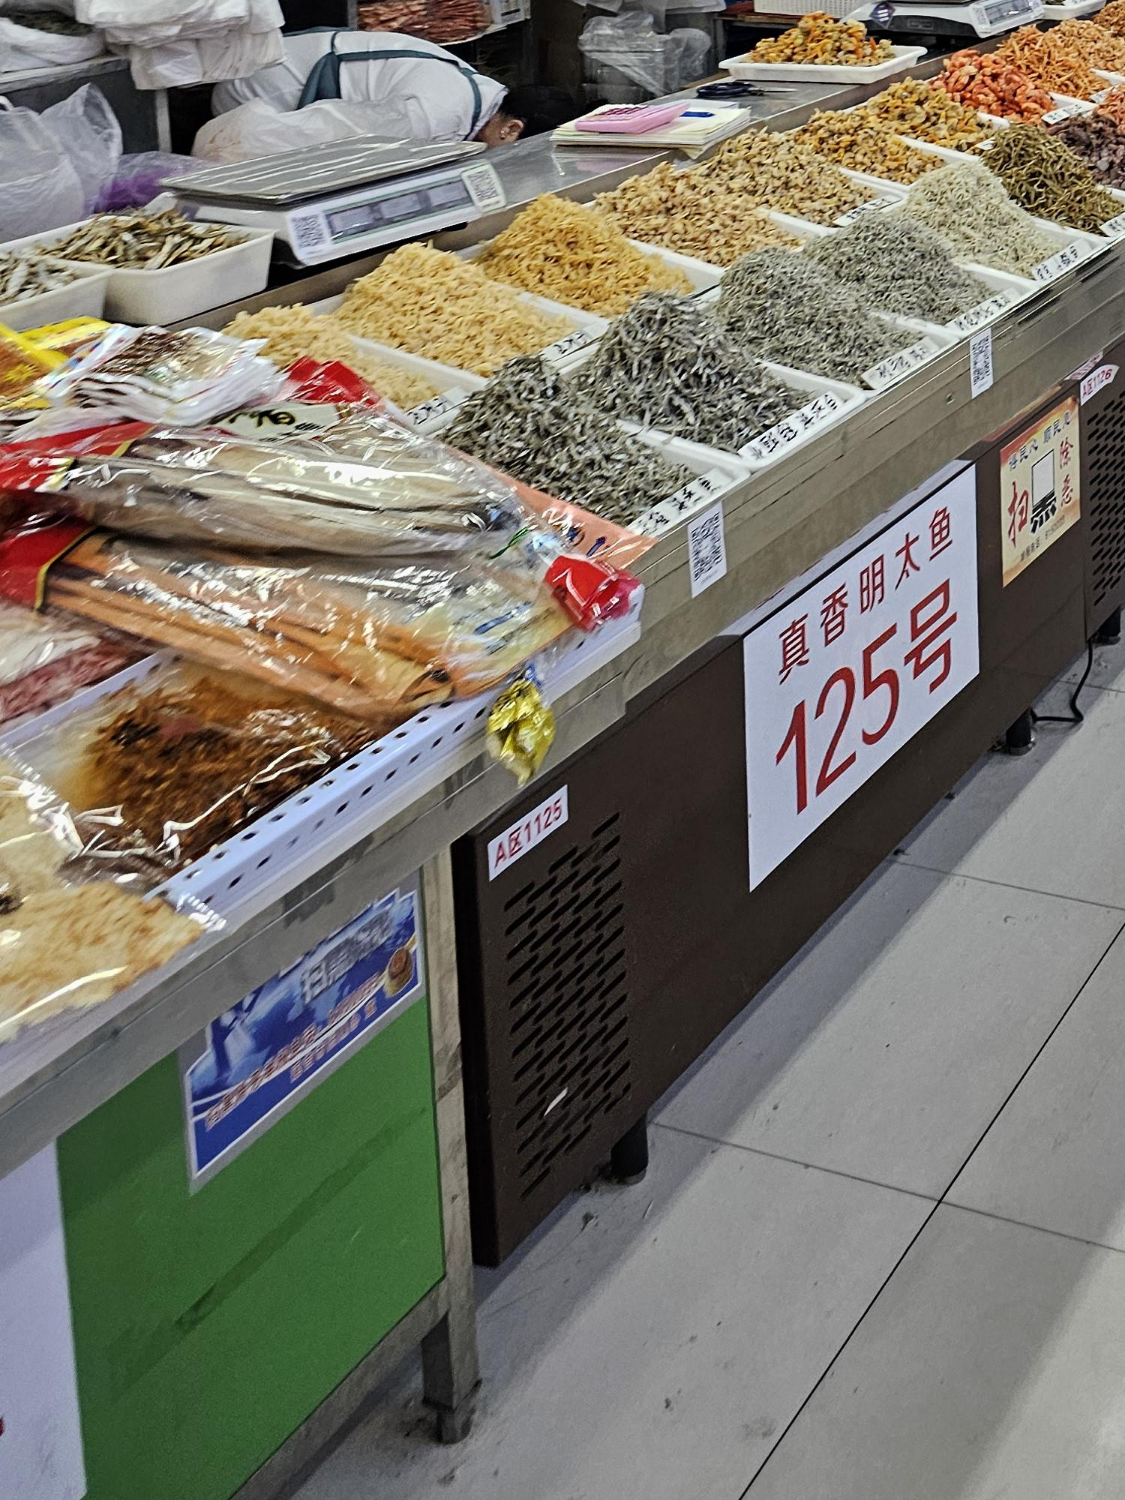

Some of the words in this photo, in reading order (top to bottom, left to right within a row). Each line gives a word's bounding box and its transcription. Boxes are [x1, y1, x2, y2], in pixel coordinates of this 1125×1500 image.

[778, 505, 953, 685] 真香明太鱼
[775, 578, 957, 815] 125号
[494, 795, 563, 869] A区1125
